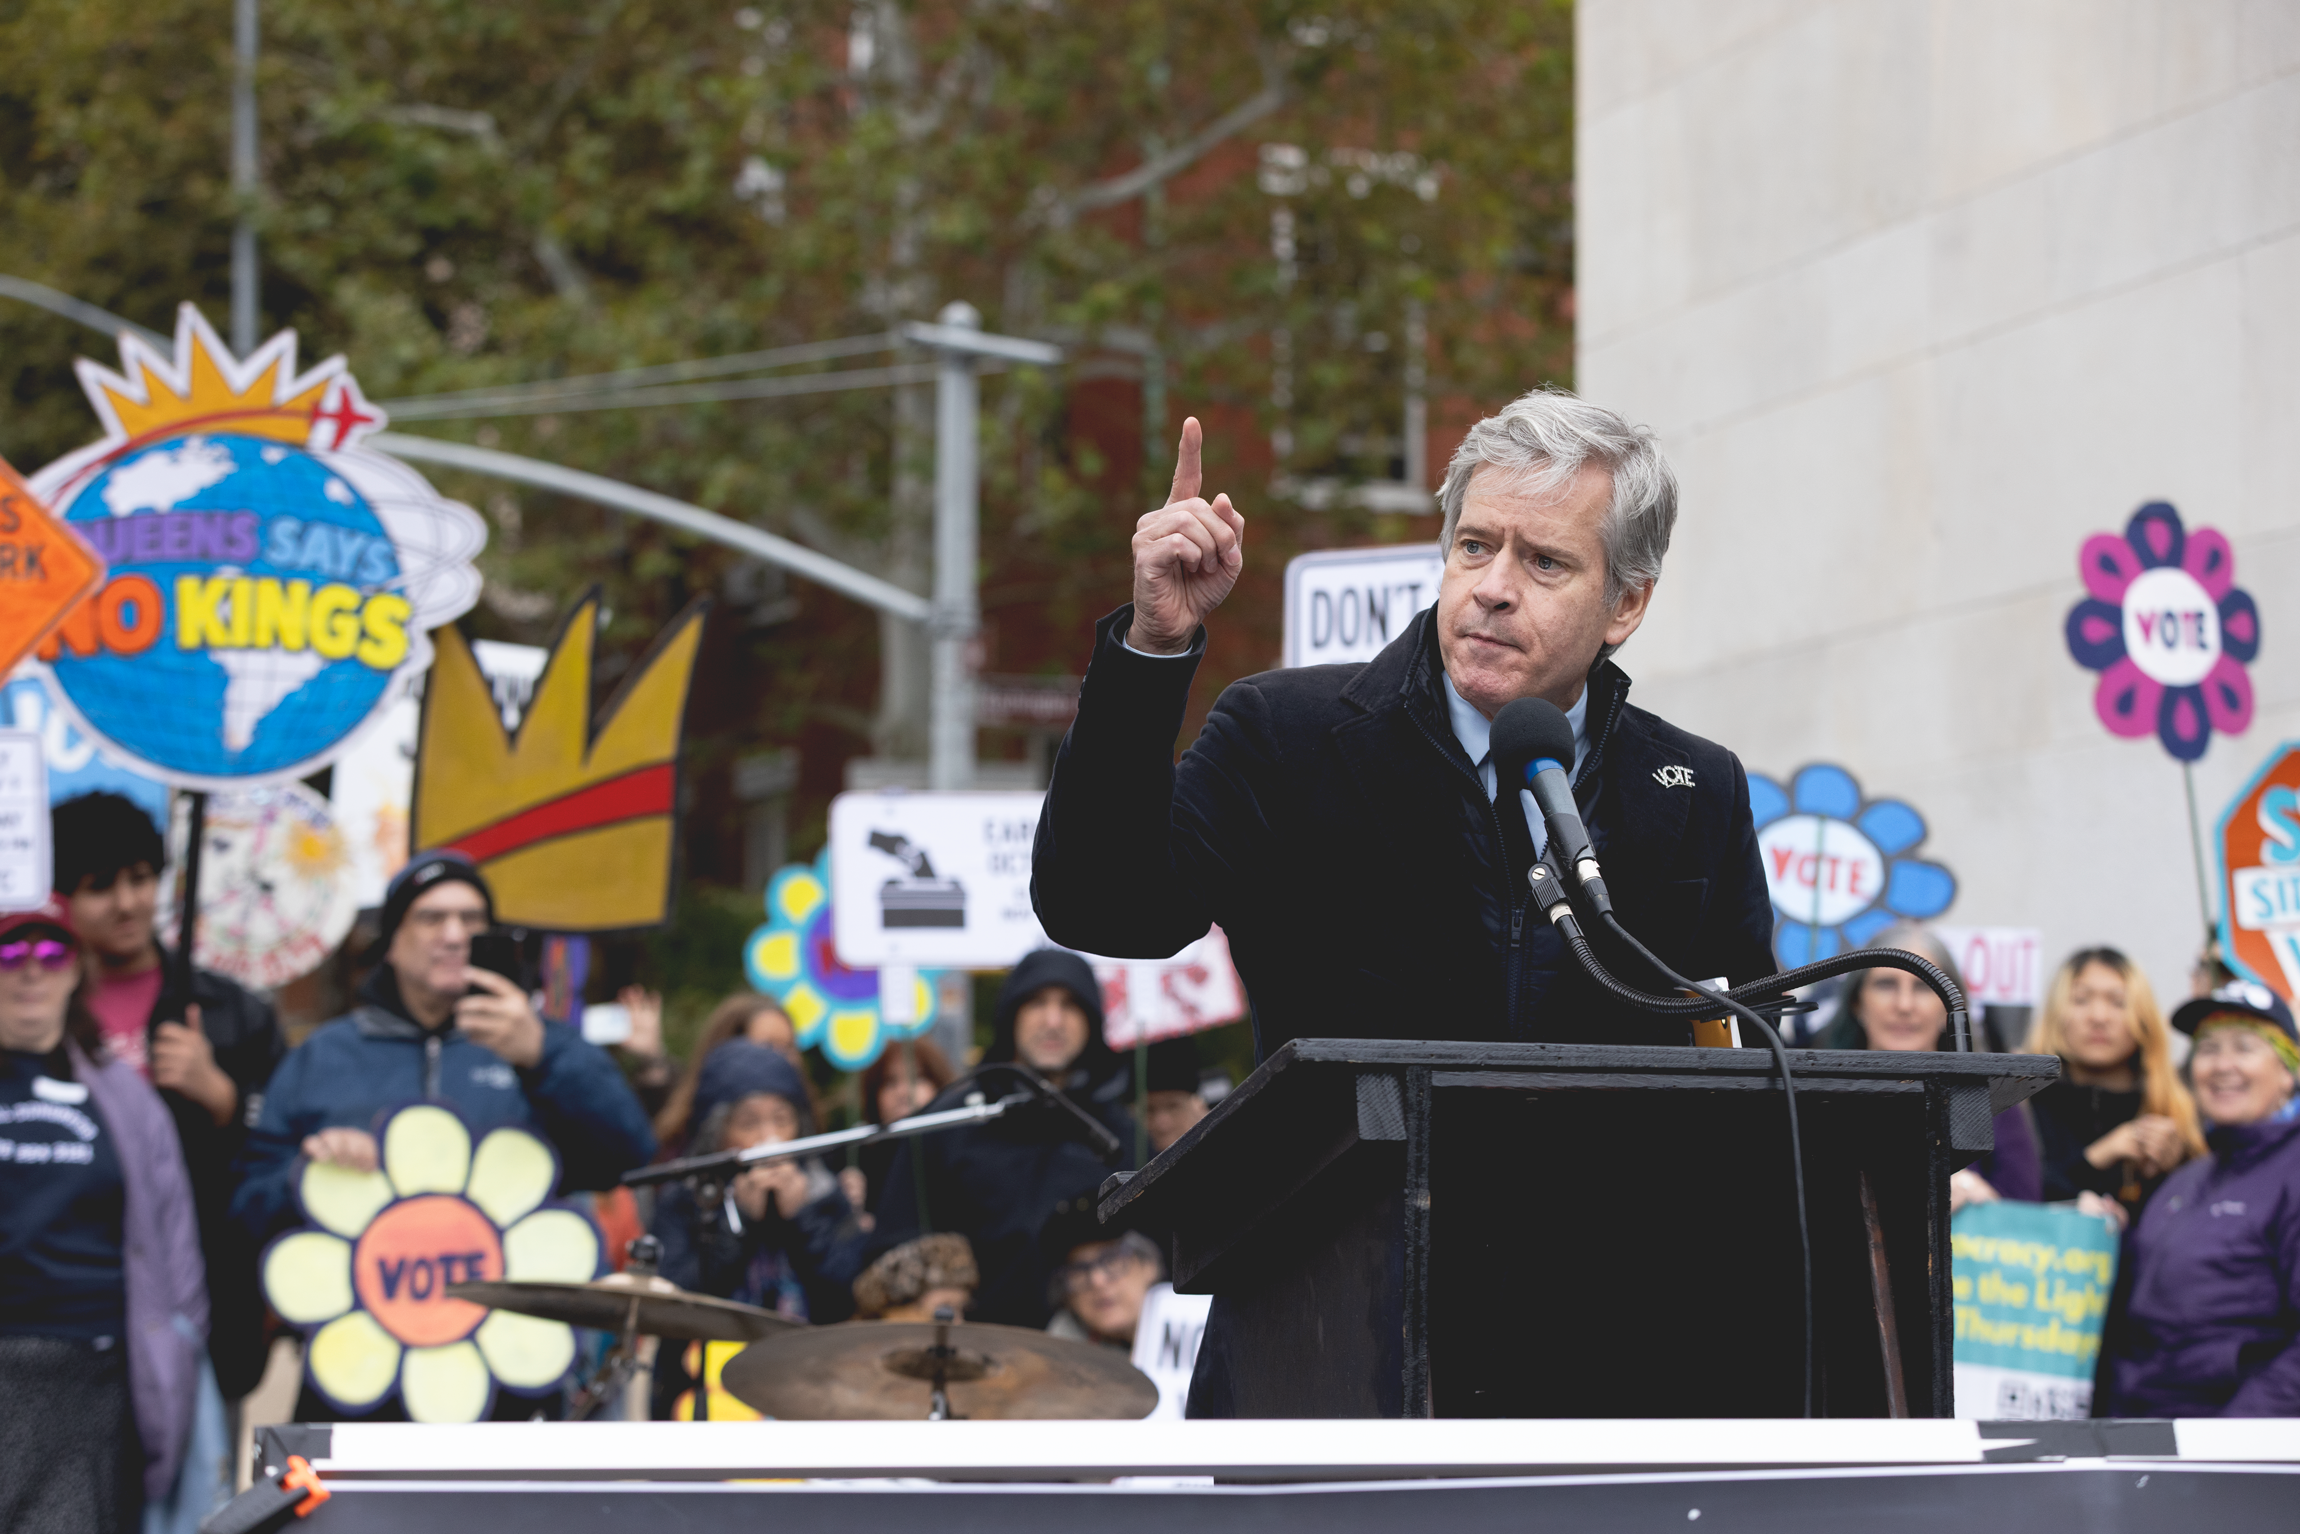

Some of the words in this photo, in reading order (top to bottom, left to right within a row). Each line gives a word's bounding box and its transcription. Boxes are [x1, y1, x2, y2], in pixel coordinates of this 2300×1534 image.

[70, 509, 259, 565] UEENS
[266, 515, 394, 586] SAYS
[177, 574, 410, 669] KINGS
[1312, 583, 1421, 648] DON'T
[2136, 611, 2209, 650] VOTE
[1652, 765, 1696, 789] VOTE
[1770, 847, 1872, 900] VOTE
[1963, 937, 2037, 997] OUT
[379, 1251, 485, 1300] VOTE
[1977, 1270, 2028, 1308] the
